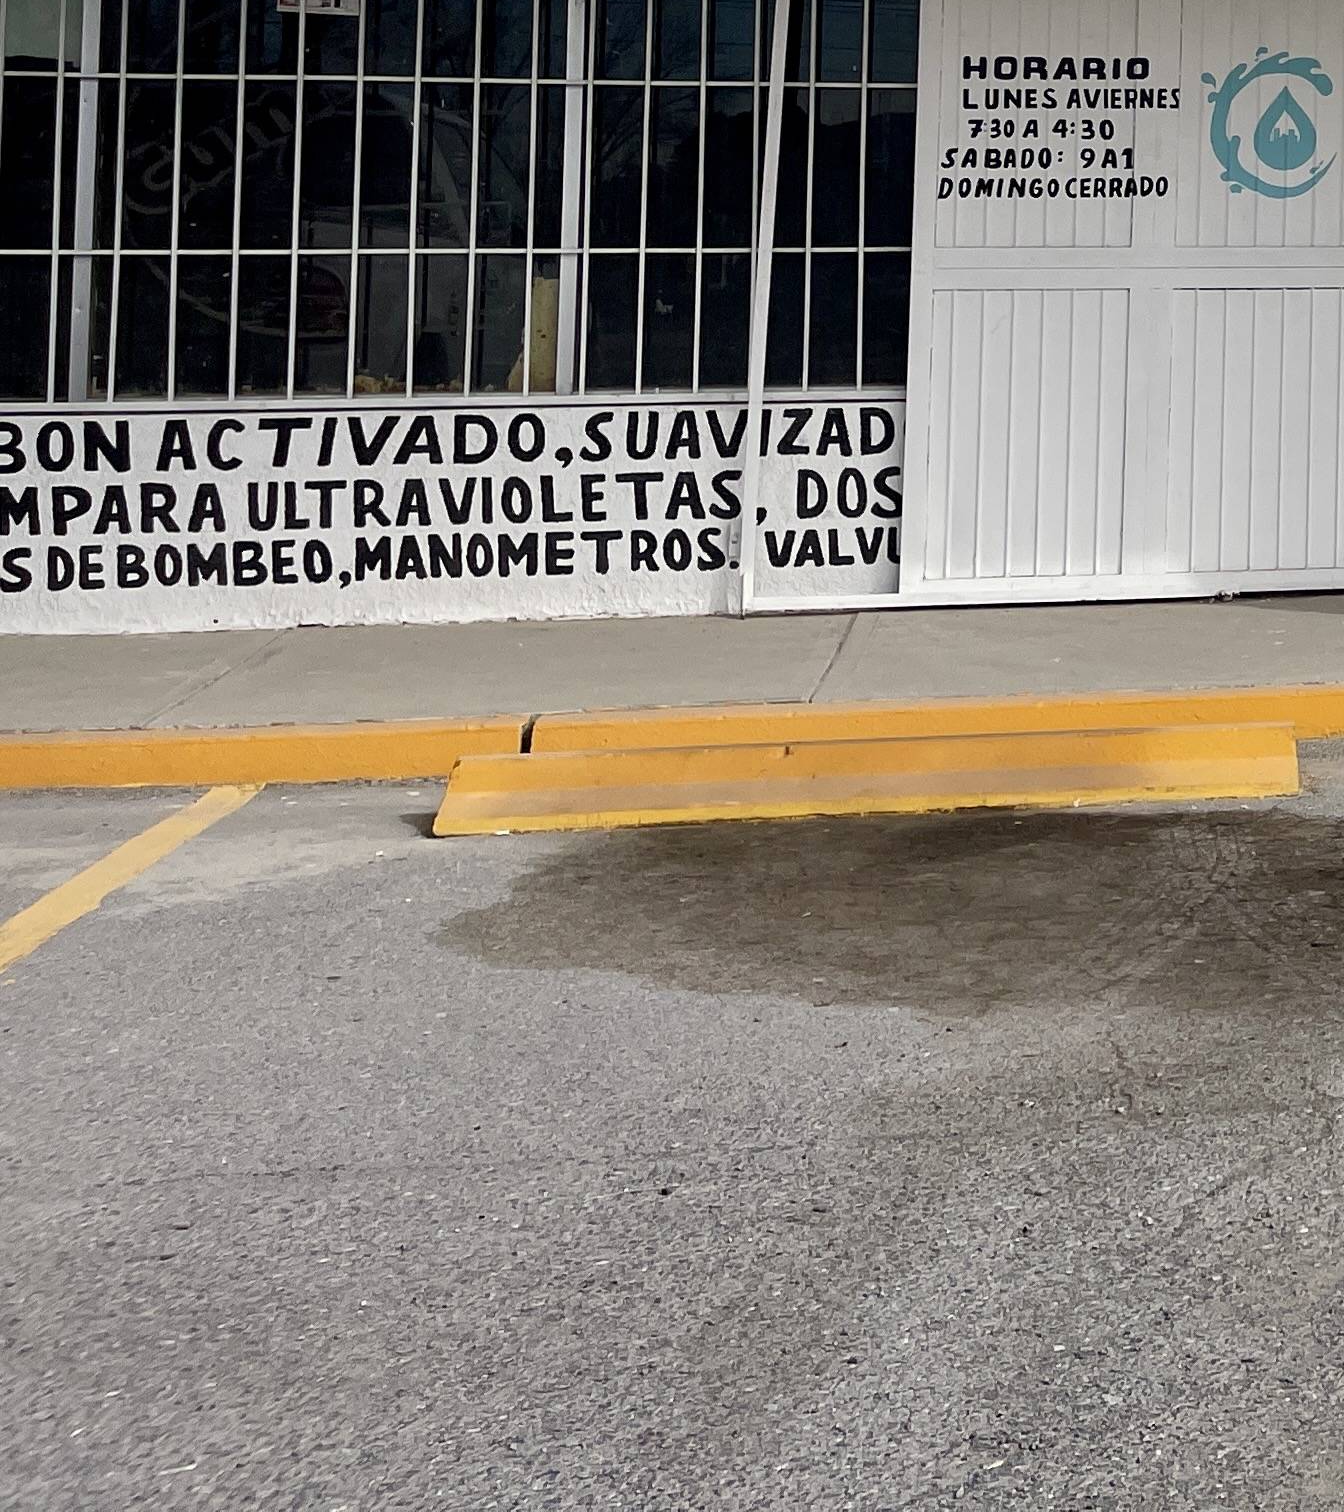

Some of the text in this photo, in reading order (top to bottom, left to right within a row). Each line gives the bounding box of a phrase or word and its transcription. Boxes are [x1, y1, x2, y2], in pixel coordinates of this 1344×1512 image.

[962, 55, 1150, 81] HORARIO
[962, 88, 1058, 110] LUNES
[1022, 119, 1039, 139] A
[1052, 119, 1115, 140] 4:30
[0, 420, 130, 474] BON
[0, 483, 226, 535] MPARA
[796, 466, 903, 521] DOS
